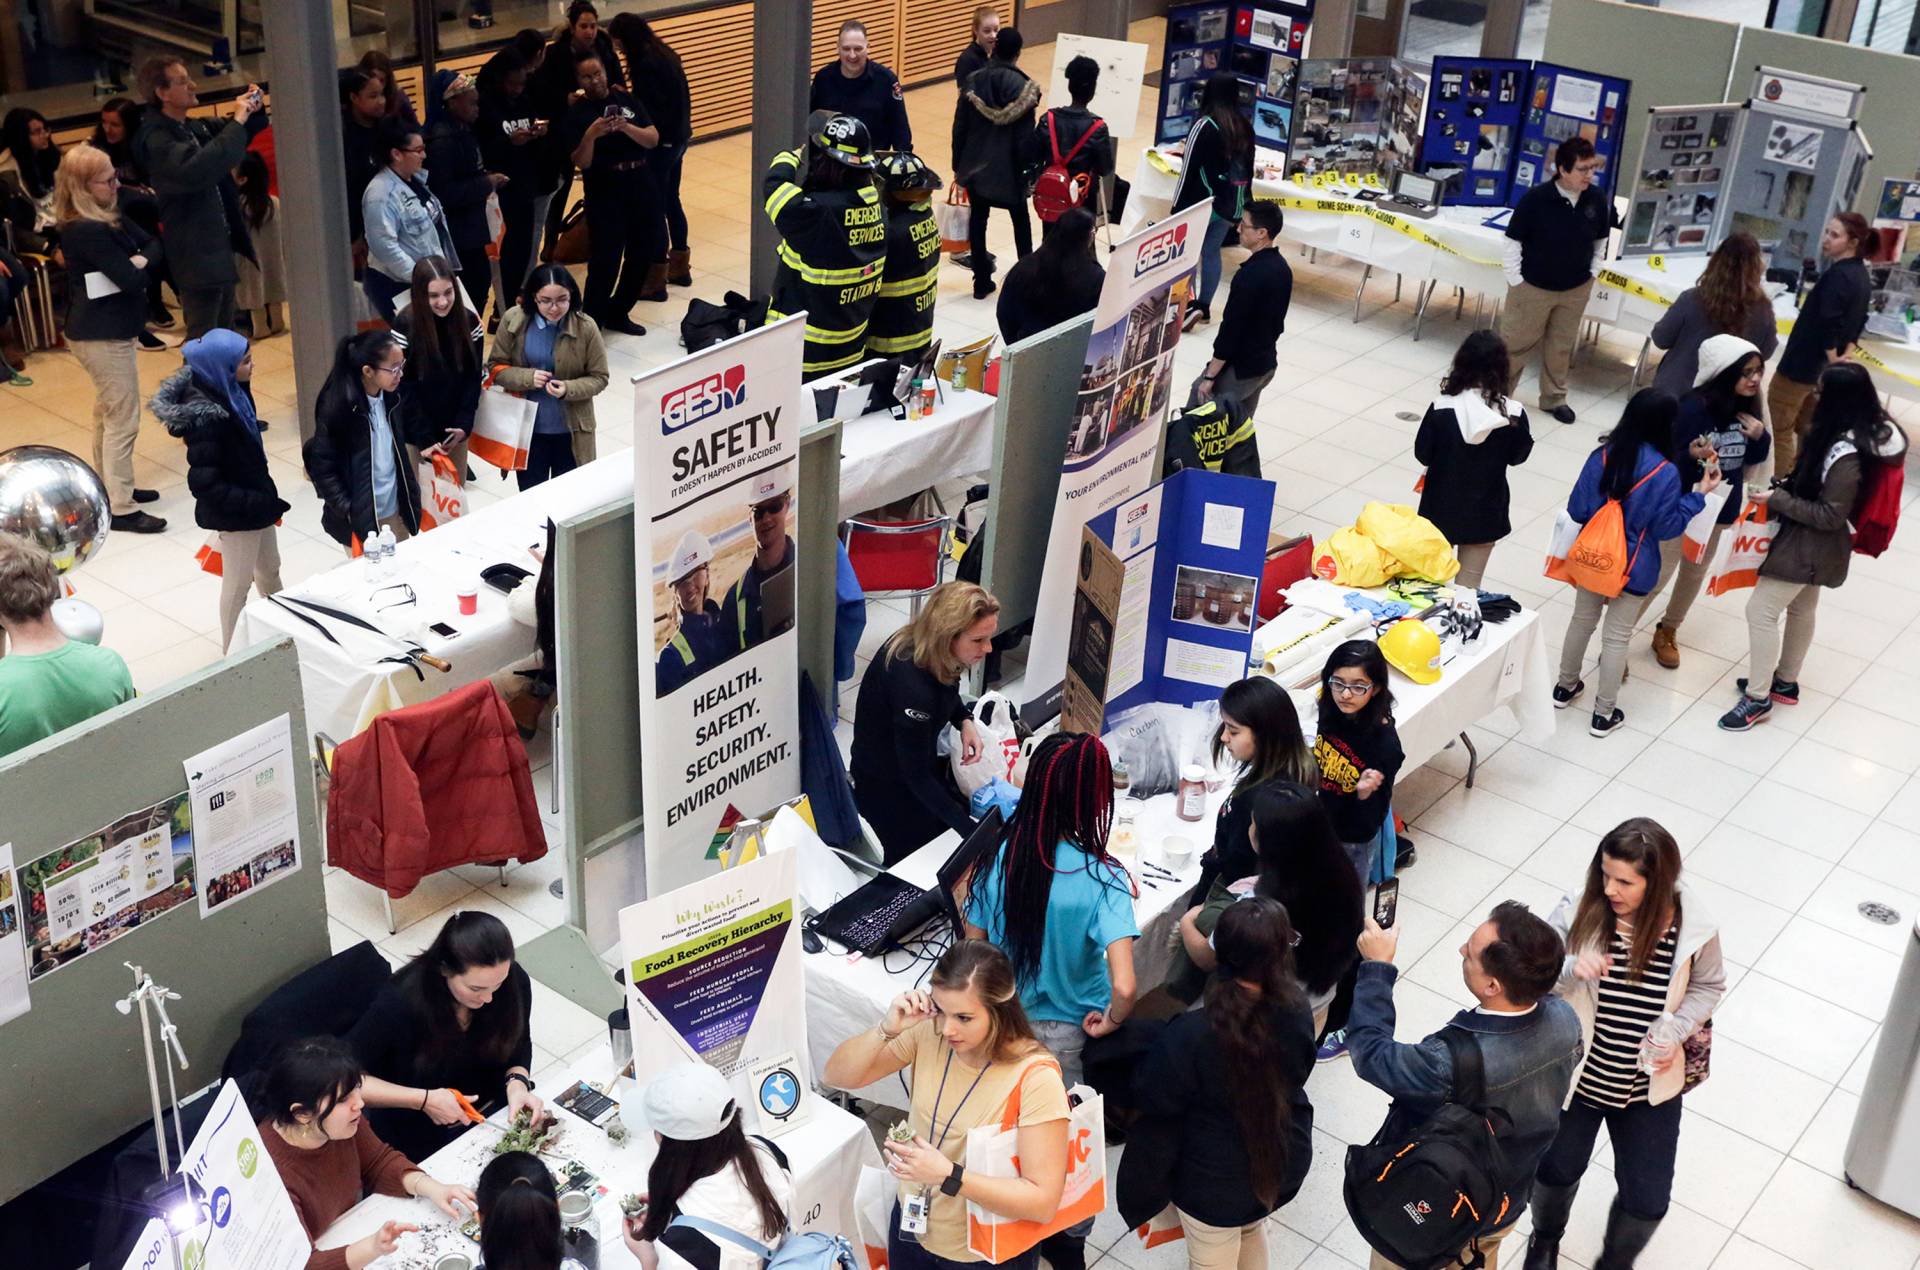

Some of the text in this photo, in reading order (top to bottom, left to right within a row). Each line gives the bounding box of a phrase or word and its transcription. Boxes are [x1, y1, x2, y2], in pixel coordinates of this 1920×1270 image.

[827, 122, 850, 139] 66
[1316, 177, 1323, 186] 2
[1330, 173, 1337, 182] 3
[1350, 175, 1356, 184] 4
[1369, 175, 1376, 184] 5
[1317, 199, 1336, 211] CRIME
[1337, 201, 1355, 212] SCENE
[1364, 205, 1375, 218] NOT
[1376, 209, 1397, 227] CROSS
[849, 223, 885, 247] SERVICES
[1350, 228, 1361, 240] 45
[1654, 256, 1661, 266] 8
[1606, 271, 1628, 288] CROSS
[839, 280, 875, 305] STATION
[1596, 291, 1609, 301] 44
[671, 405, 782, 483] SAFETY
[671, 443, 783, 499] IT DOESN'T HAPPEN BY ACCIDENT
[1065, 483, 1088, 501] YOUR
[1088, 456, 1140, 492] ENVIRONMENTAL
[693, 667, 763, 718] HEALTH.
[696, 698, 761, 747] SAFETY.
[1129, 717, 1160, 738] Carbon
[686, 722, 772, 784] SECURITY.
[666, 741, 792, 828] ENVIRONMENT.
[687, 921, 702, 932] your
[701, 914, 721, 926] actions
[728, 903, 749, 916] prevent
[749, 897, 760, 907] and
[685, 927, 703, 938] divert
[703, 920, 723, 932] wasted
[645, 911, 784, 974] Food Recovery Hierarchy
[688, 947, 747, 975] SOURCE REDUCTION
[689, 966, 754, 997] FEED HUNGRY PEOPLE
[700, 993, 743, 1016] FEED ANIMALS
[697, 1020, 733, 1038] INDUSTRIAL
[733, 1012, 749, 1023] USES
[802, 1203, 821, 1226] 40
